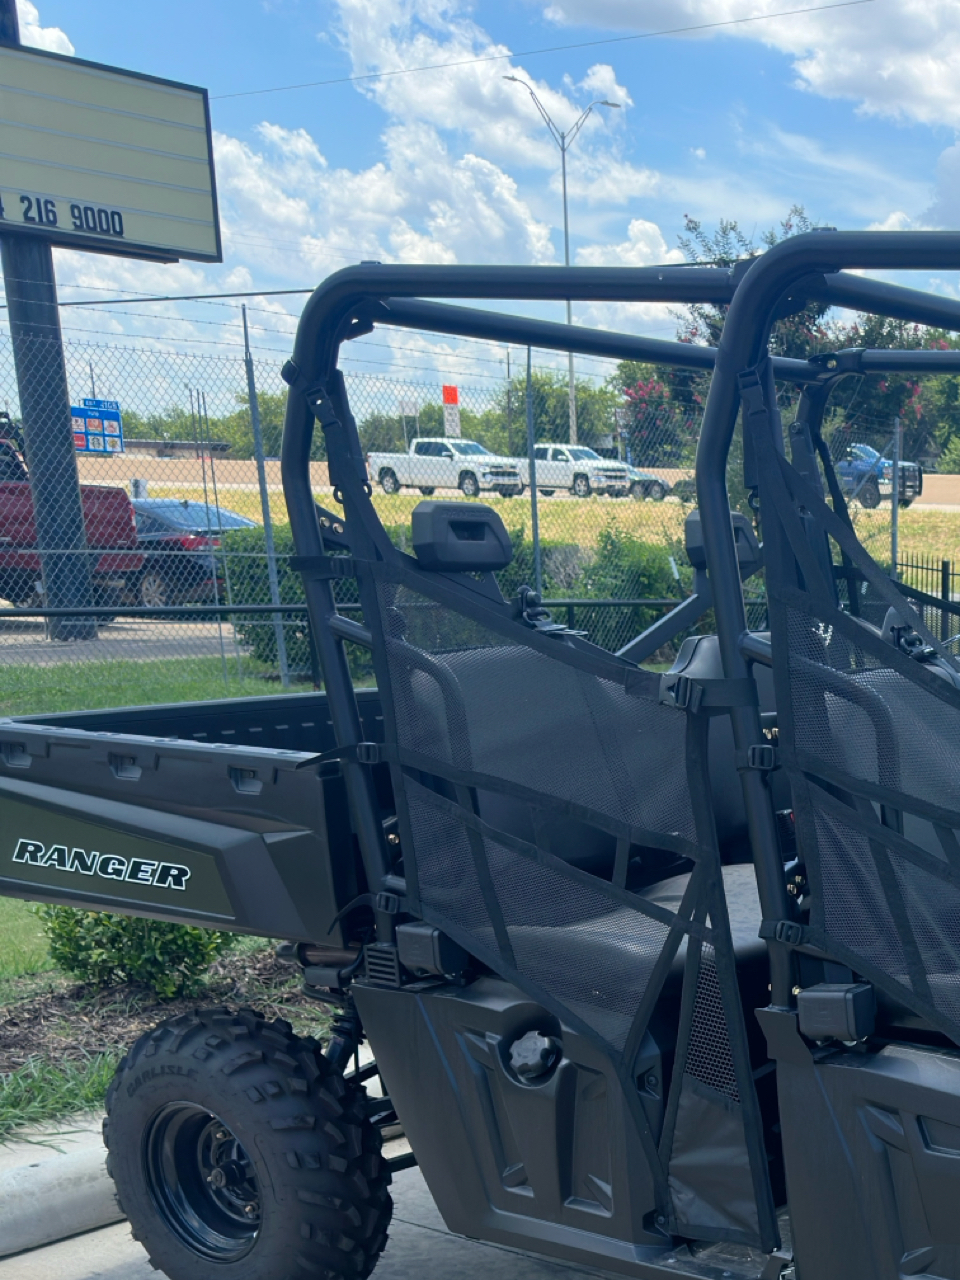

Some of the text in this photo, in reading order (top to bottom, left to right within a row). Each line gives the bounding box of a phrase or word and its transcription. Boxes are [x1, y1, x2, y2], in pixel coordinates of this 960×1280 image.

[19, 195, 58, 227] 216
[70, 203, 125, 237] 9000
[12, 838, 191, 890] RANGER
